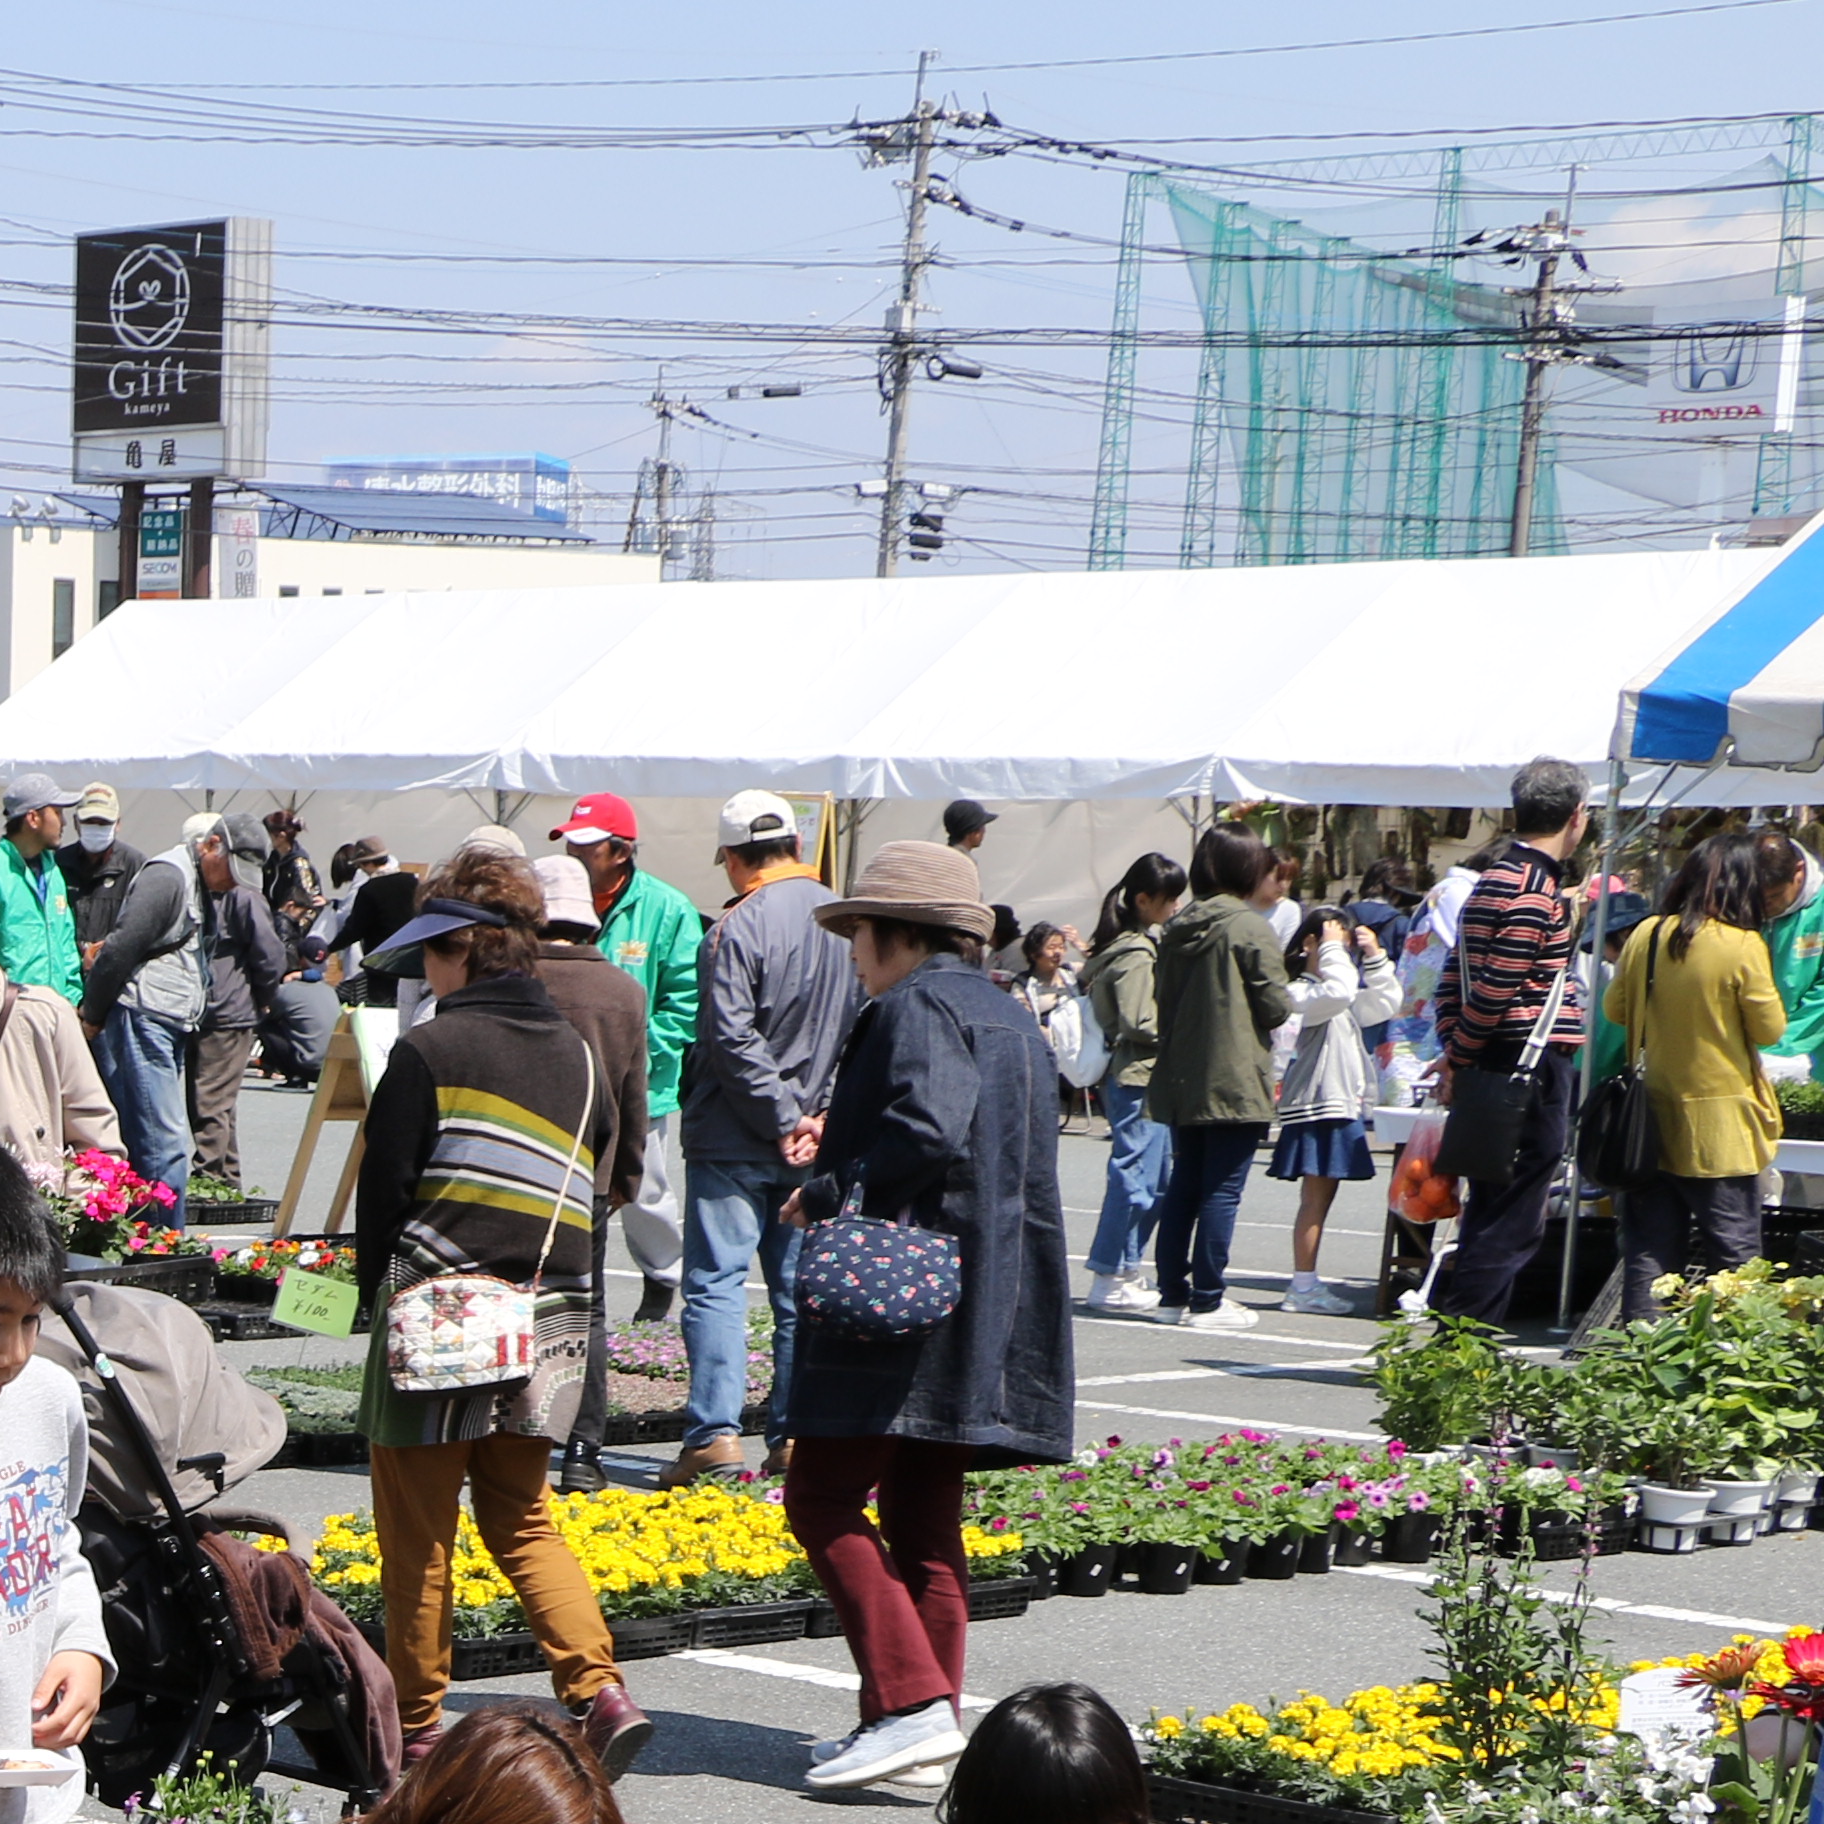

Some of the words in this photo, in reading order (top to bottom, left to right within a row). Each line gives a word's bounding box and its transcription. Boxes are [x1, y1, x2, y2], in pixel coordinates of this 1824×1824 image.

[108, 356, 188, 399] Gift
[124, 402, 170, 416] kameya
[1657, 404, 1763, 424] HONDA
[125, 439, 176, 468] 亀屋
[142, 562, 177, 574] SECOM
